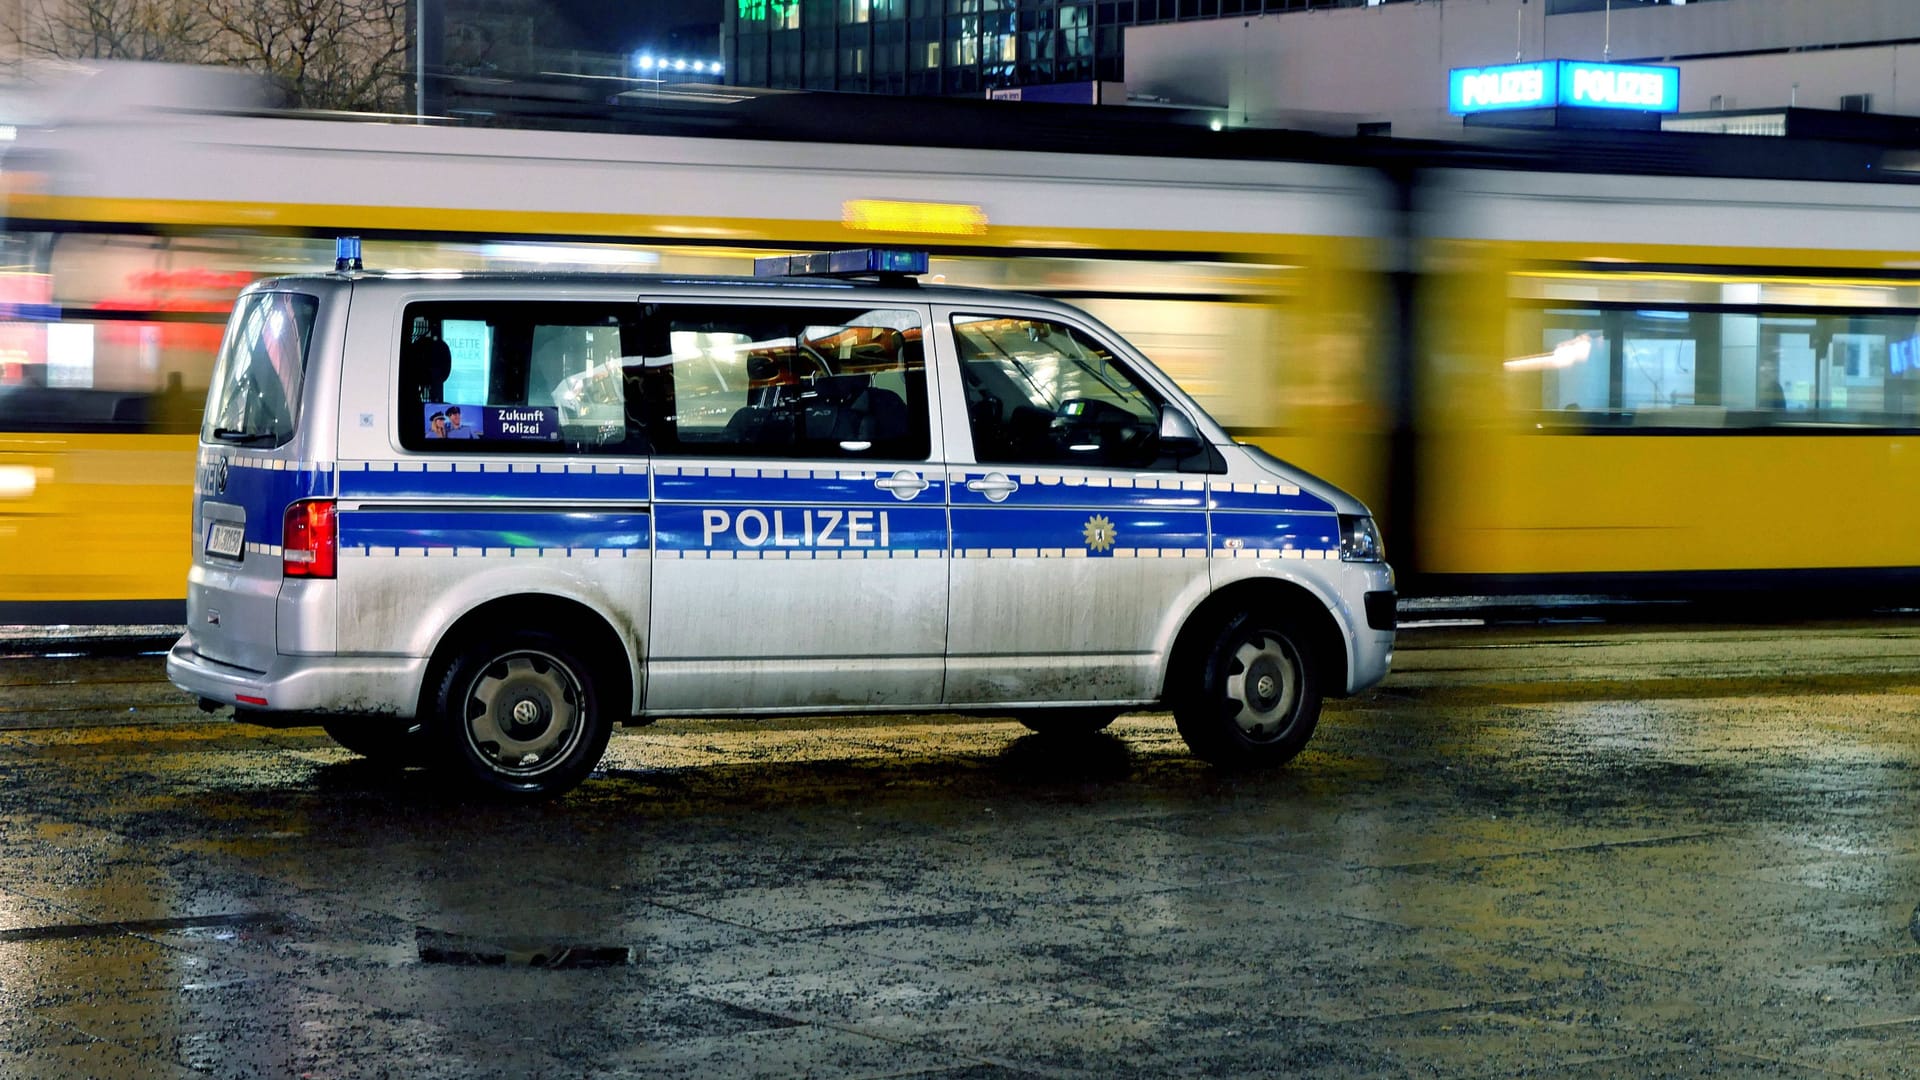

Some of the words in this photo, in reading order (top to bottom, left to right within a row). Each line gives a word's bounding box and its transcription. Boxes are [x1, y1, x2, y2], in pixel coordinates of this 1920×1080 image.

[1462, 70, 1543, 106] POLIZEI
[1574, 68, 1663, 105] POLIZEI
[498, 409, 544, 421] Zukunft
[502, 422, 539, 434] Polizei
[703, 509, 889, 547] POLIZEI
